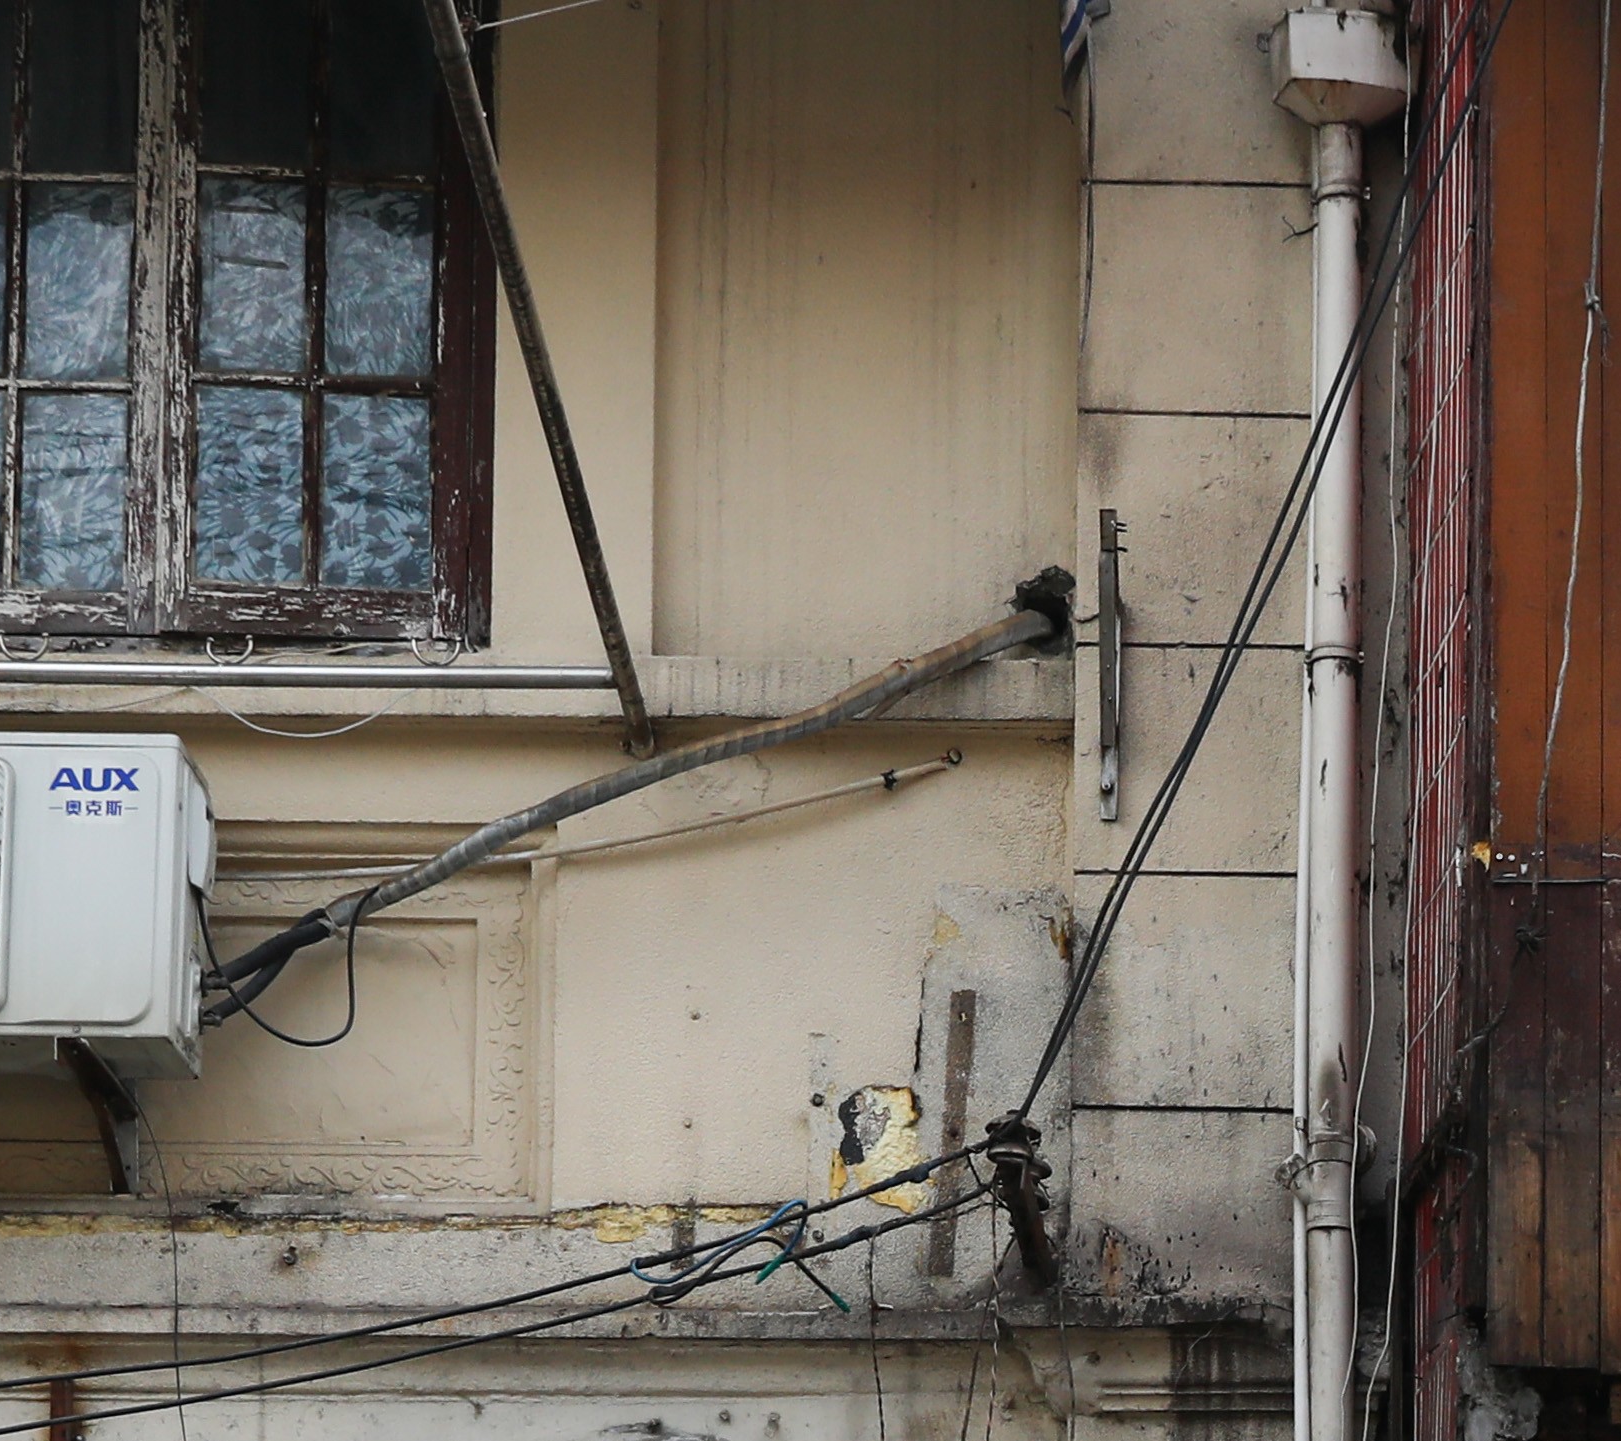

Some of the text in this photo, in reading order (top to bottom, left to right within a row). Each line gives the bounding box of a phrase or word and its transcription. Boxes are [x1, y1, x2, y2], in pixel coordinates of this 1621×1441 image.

[49, 768, 139, 792] AUX
[65, 800, 123, 816] 奥克斯
